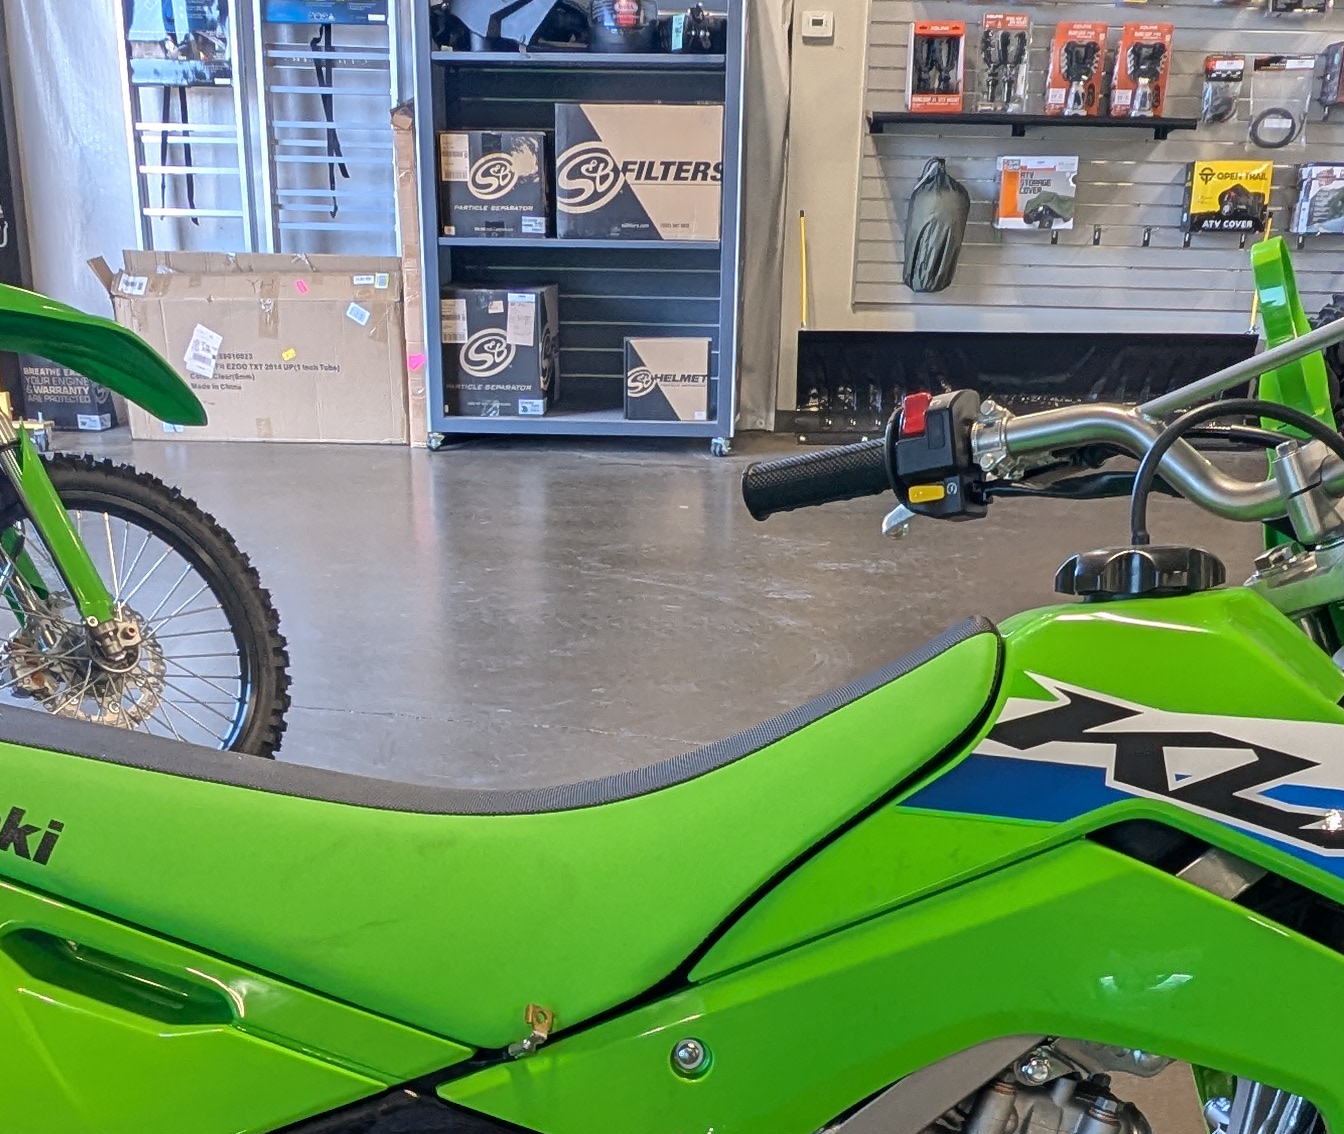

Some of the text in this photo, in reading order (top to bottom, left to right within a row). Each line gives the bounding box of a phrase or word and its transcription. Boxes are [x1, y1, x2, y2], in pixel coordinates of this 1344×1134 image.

[621, 161, 723, 182] FILTERS
[23, 367, 61, 376] BREATHE
[25, 376, 90, 386] YOUR ENGINE
